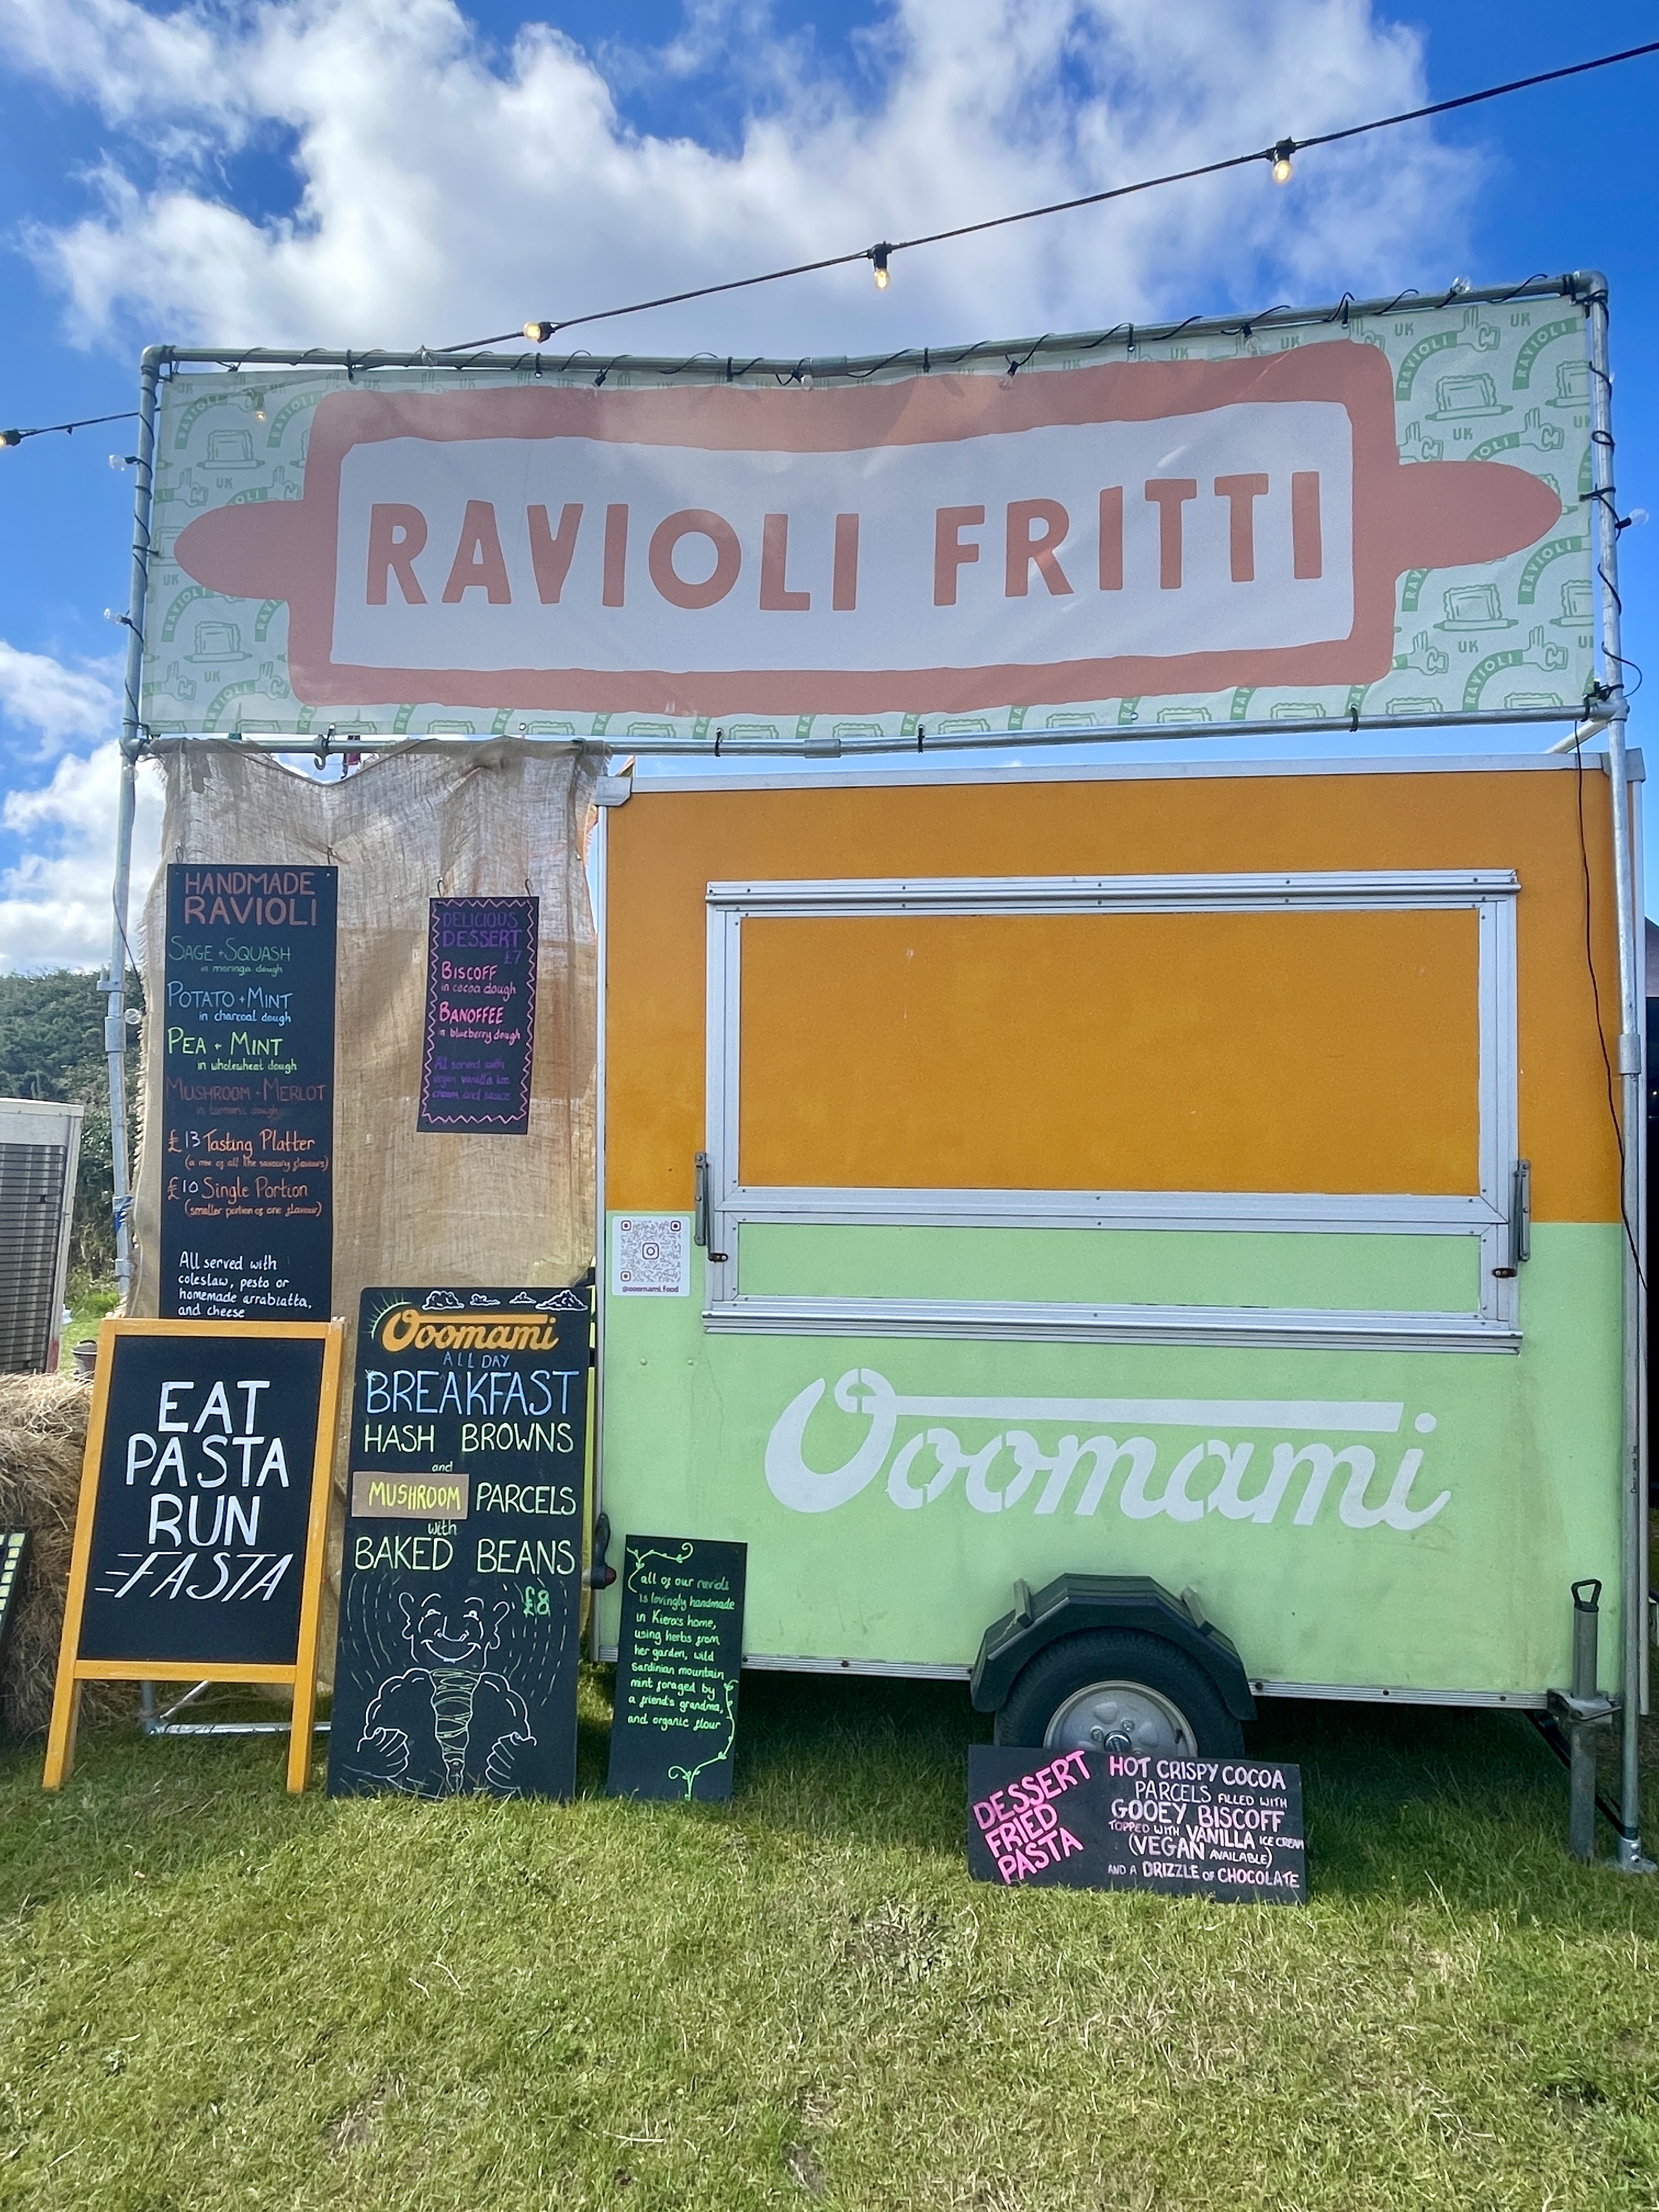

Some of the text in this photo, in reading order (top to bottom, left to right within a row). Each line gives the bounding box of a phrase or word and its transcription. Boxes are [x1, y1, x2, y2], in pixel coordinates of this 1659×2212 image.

[1395, 323, 1414, 336] UK
[1510, 313, 1530, 327] UK
[1171, 347, 1188, 360] UK
[1399, 334, 1448, 388] RAVIOLI
[1516, 321, 1567, 378] RAVIOLI
[271, 396, 315, 438] RAVIOLI
[1453, 428, 1473, 441] UK
[216, 477, 233, 489] UK
[366, 471, 1325, 612] RAVIOLI FRITTI
[1521, 540, 1571, 592] RAVIOLI
[163, 574, 179, 586] UK
[165, 586, 206, 631] RAVIOLI
[1458, 640, 1479, 653] UK
[204, 671, 220, 682] UK
[1465, 653, 1513, 704] RAVIOLI
[185, 872, 315, 895] HANDMADE
[184, 896, 317, 926] RAVIOLI
[443, 911, 518, 928] DELICIOUS
[168, 935, 291, 962] SAGE SQUASH
[443, 929, 522, 948] DESSERT
[213, 964, 251, 977] moringa
[256, 964, 283, 977] dough
[442, 961, 498, 980] BISCOFF
[167, 981, 234, 1008] POTATO
[247, 987, 294, 1009] MINT
[441, 981, 516, 1002] in cocoa dough
[199, 1010, 291, 1026] in charcoal dough
[439, 1001, 504, 1024] BANOFFEE
[167, 1027, 206, 1054] PEA
[230, 1031, 283, 1056] MINT
[439, 1027, 521, 1046] in blueberry dough
[198, 1058, 297, 1074] in wholewheat dough
[166, 1076, 326, 1102] MUSHROOM MERLOT
[203, 1128, 253, 1158] Tasting
[259, 1128, 315, 1152] Platter
[227, 1157, 239, 1168] all
[202, 1176, 249, 1205] Single
[255, 1176, 308, 1198] Portion
[185, 1198, 221, 1217] (smaller
[225, 1206, 253, 1218] portion
[266, 1206, 281, 1215] one
[179, 1251, 277, 1271] All served with
[178, 1272, 290, 1292] coleslaw, pesto or
[179, 1288, 312, 1309] homemade arrabiatta,
[178, 1304, 245, 1318] and cheese
[382, 1309, 560, 1352] Ooomami
[443, 1351, 510, 1368] ALL DAY
[366, 1370, 579, 1416] BREAKFAST
[158, 1380, 270, 1435] EAT
[364, 1423, 574, 1454] HASH BROWNS
[764, 1368, 1452, 1531] Ooomami
[126, 1432, 289, 1488] PASTA
[432, 1461, 453, 1472] and
[369, 1481, 577, 1516] MUSHROOM PARCELS
[148, 1493, 260, 1547] RUN
[428, 1521, 457, 1536] with
[354, 1536, 575, 1575] BAKED BEANS
[115, 1551, 294, 1602] FASTA
[641, 1572, 656, 1584] all
[661, 1577, 671, 1589] of
[675, 1578, 694, 1587] our
[523, 1585, 550, 1616] £8
[639, 1592, 735, 1611] is lovingly handmade
[636, 1612, 646, 1622] in
[687, 1615, 716, 1630] home,
[635, 1629, 720, 1646] using herbs from
[635, 1644, 714, 1662] her garden, wild
[631, 1662, 724, 1680] Sardinian mountain
[631, 1677, 715, 1701] mint foraged by
[639, 1695, 675, 1708] friend's
[680, 1700, 724, 1714] grandma,
[628, 1713, 721, 1731] and organic flour
[1109, 1756, 1286, 1790] HOT CRISPY COCOA
[973, 1750, 1091, 1830] DESSERT
[1136, 1780, 1288, 1808] PARCELS FILLED WITH
[1111, 1798, 1284, 1832] GOOEY BISCOFF
[985, 1804, 1058, 1859] FRIED
[1108, 1820, 1150, 1833] TOPPED
[1153, 1825, 1180, 1836] WITH
[1186, 1824, 1256, 1850] VANILLA
[1260, 1836, 1274, 1847] ICE
[997, 1827, 1084, 1885] PASTA
[1129, 1833, 1273, 1869] (VEGAN AVAILABLE)
[1108, 1865, 1126, 1875] AND
[1130, 1865, 1137, 1875] A
[1142, 1861, 1200, 1880] DRIZZLE
[1217, 1867, 1300, 1888] CHOCOLATE
